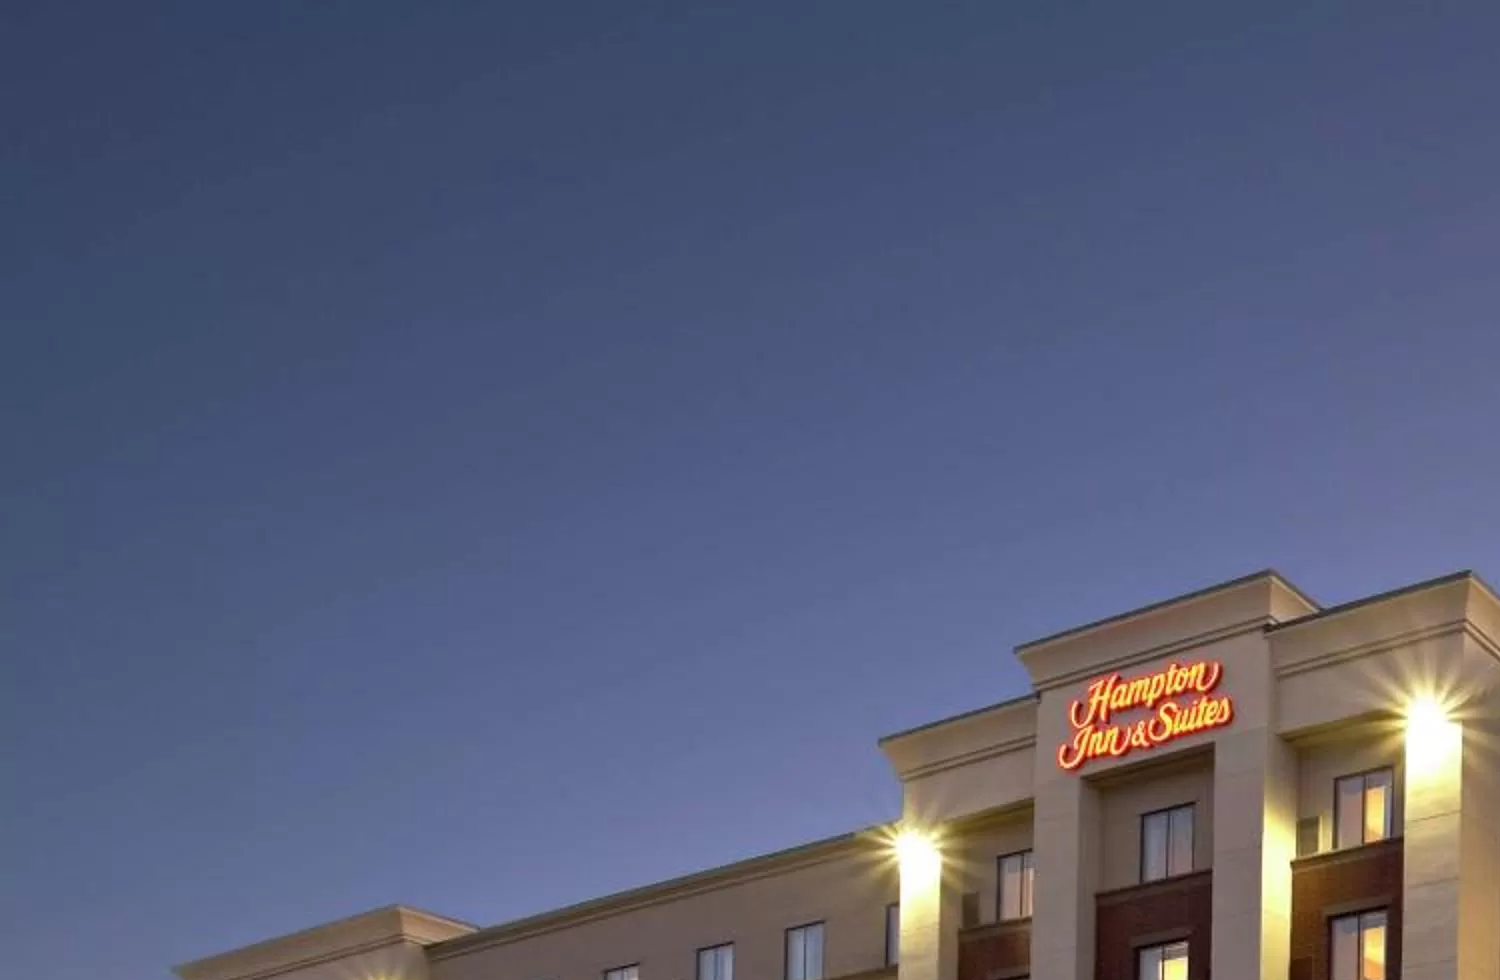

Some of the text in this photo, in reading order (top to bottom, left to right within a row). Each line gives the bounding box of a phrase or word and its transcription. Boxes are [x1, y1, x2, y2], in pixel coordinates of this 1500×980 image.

[1070, 660, 1223, 729] Hampton
[1058, 695, 1231, 770] Inn & Suites
